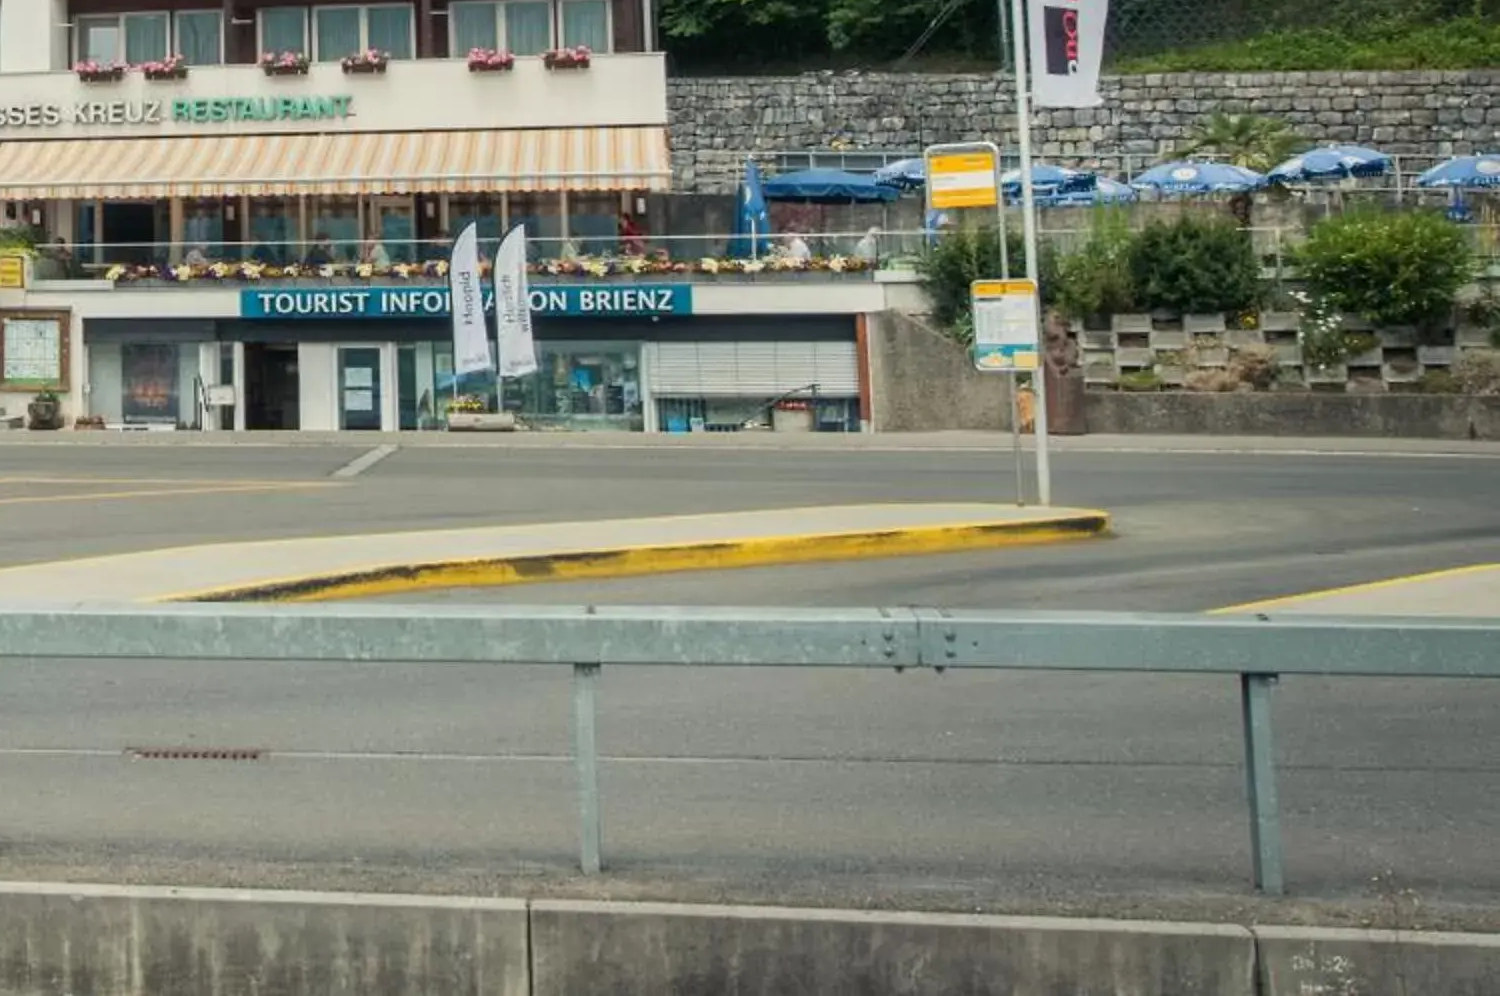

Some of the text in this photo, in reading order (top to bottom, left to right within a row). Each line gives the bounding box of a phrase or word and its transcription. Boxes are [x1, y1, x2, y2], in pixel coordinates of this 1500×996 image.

[72, 99, 163, 125] KREUZ
[172, 95, 354, 122] RESTAURANT
[258, 293, 369, 312] TOURIST
[579, 290, 673, 311] BRIENZ
